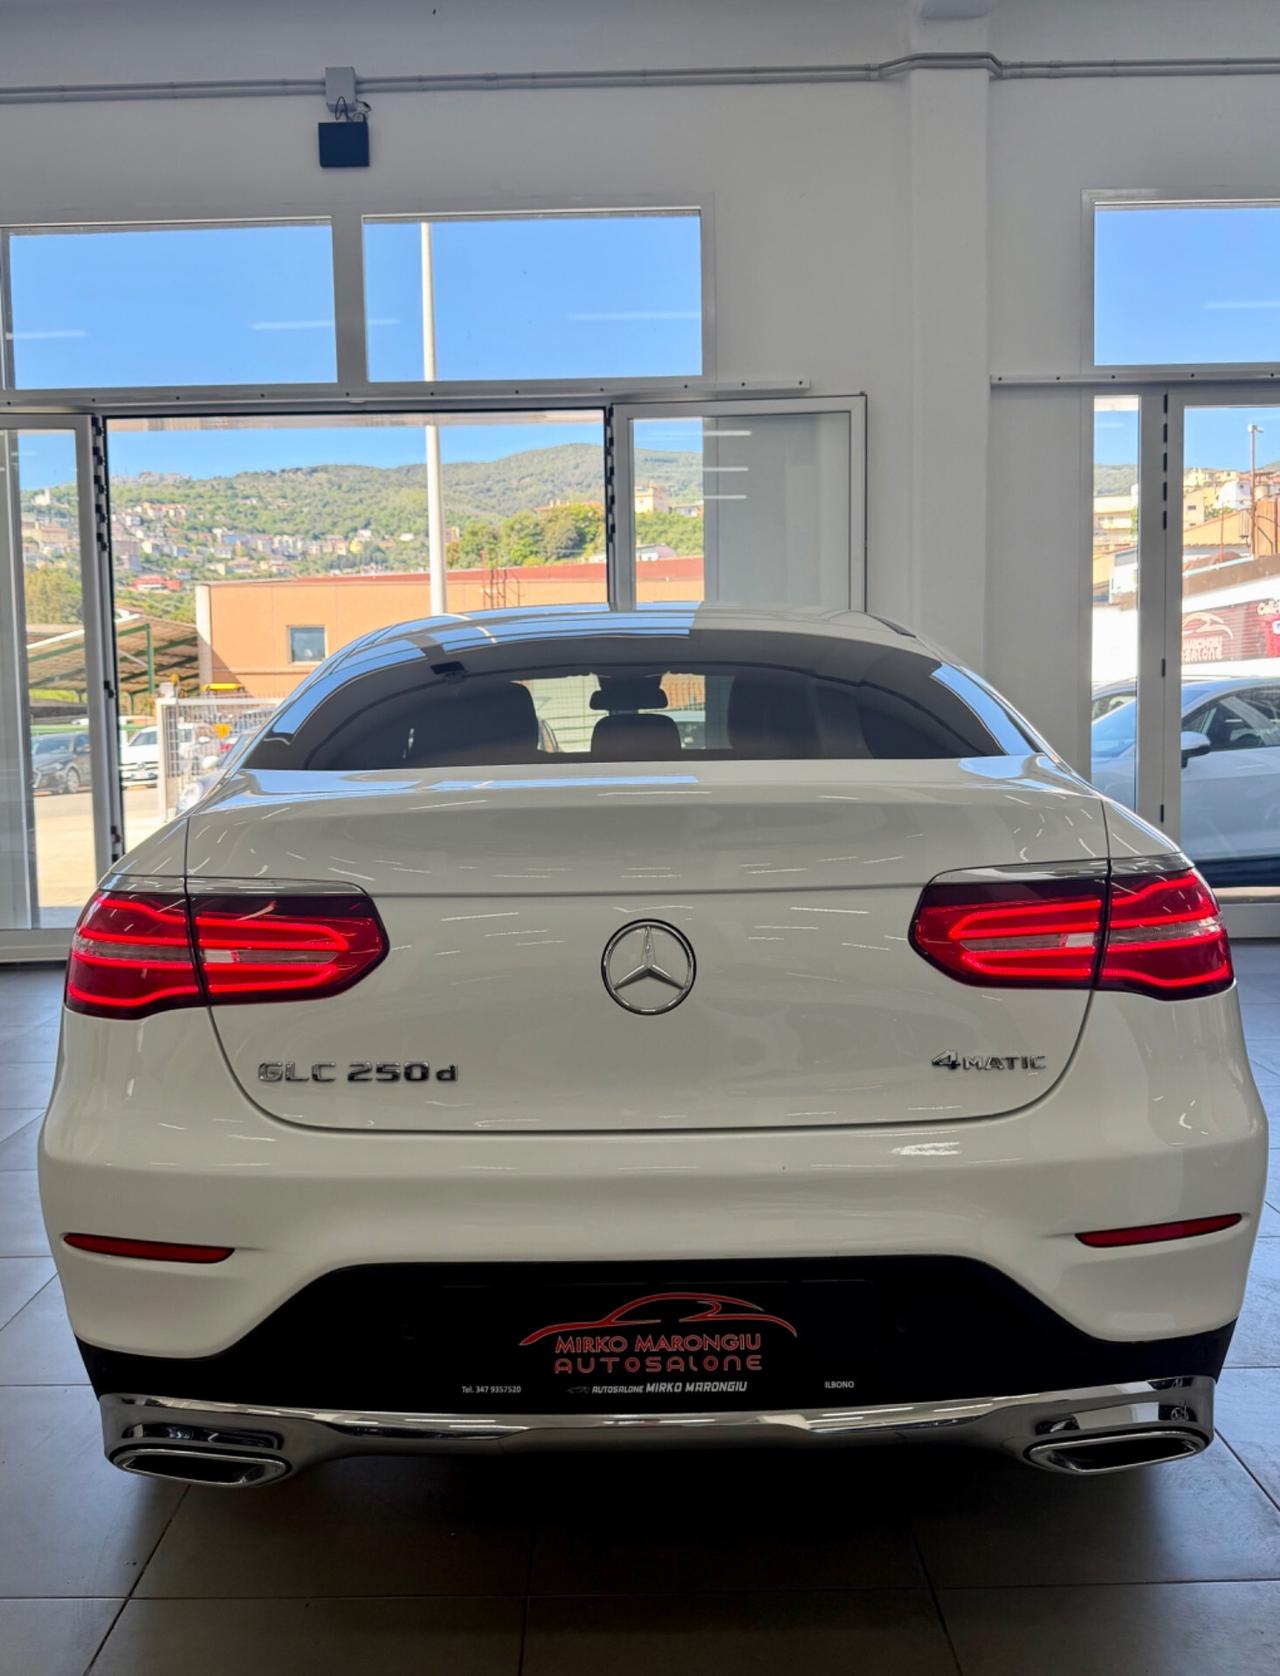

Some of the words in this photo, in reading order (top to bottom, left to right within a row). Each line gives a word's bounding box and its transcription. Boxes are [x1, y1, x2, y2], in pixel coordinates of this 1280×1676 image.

[931, 1048, 1047, 1070] 4MATIC
[258, 1062, 336, 1082] GLC
[554, 1335, 628, 1354] MIRKO
[634, 1333, 762, 1352] MARONGIU
[554, 1354, 763, 1375] AUTOSALONE
[461, 1385, 474, 1394] Tel.
[475, 1385, 489, 1394] 347
[591, 1384, 645, 1395] AUTOSALONE
[645, 1381, 683, 1394] MIRKO
[684, 1380, 748, 1393] MARONGIU
[824, 1380, 855, 1389] ILBONO
